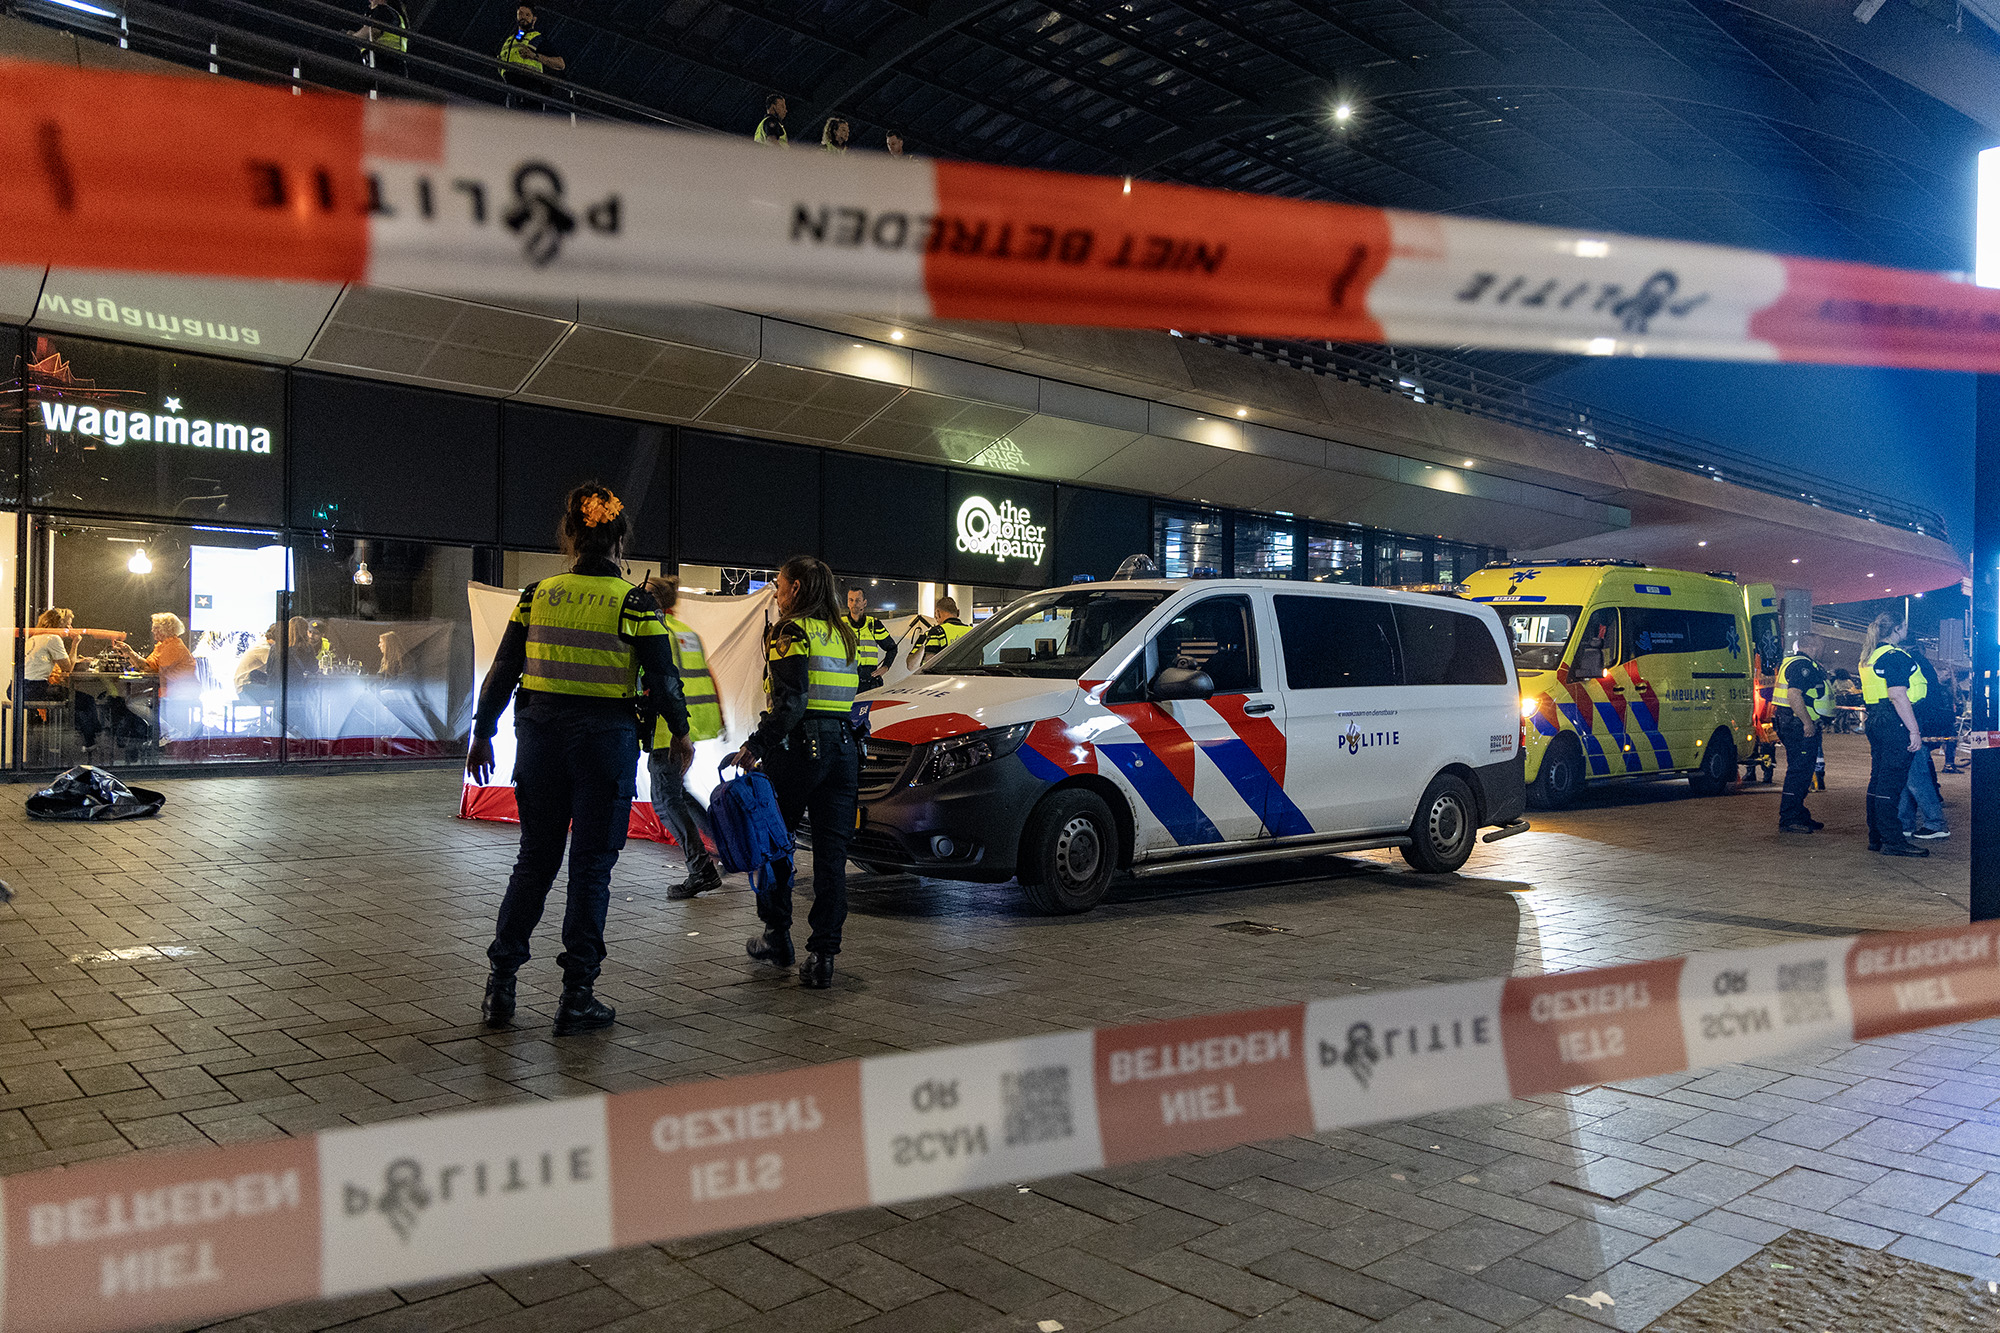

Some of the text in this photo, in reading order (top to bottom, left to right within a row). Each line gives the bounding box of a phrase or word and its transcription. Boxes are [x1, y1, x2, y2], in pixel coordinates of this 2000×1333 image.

[790, 203, 1227, 275] NIET BETREDEN
[41, 400, 272, 454] wagamama
[999, 499, 1031, 525] the
[956, 535, 1046, 566] company
[536, 582, 619, 607] POLITIE
[1665, 688, 1715, 701] AMBULANCE
[1338, 720, 1399, 755] POLITIE
[1501, 734, 1512, 745] 112
